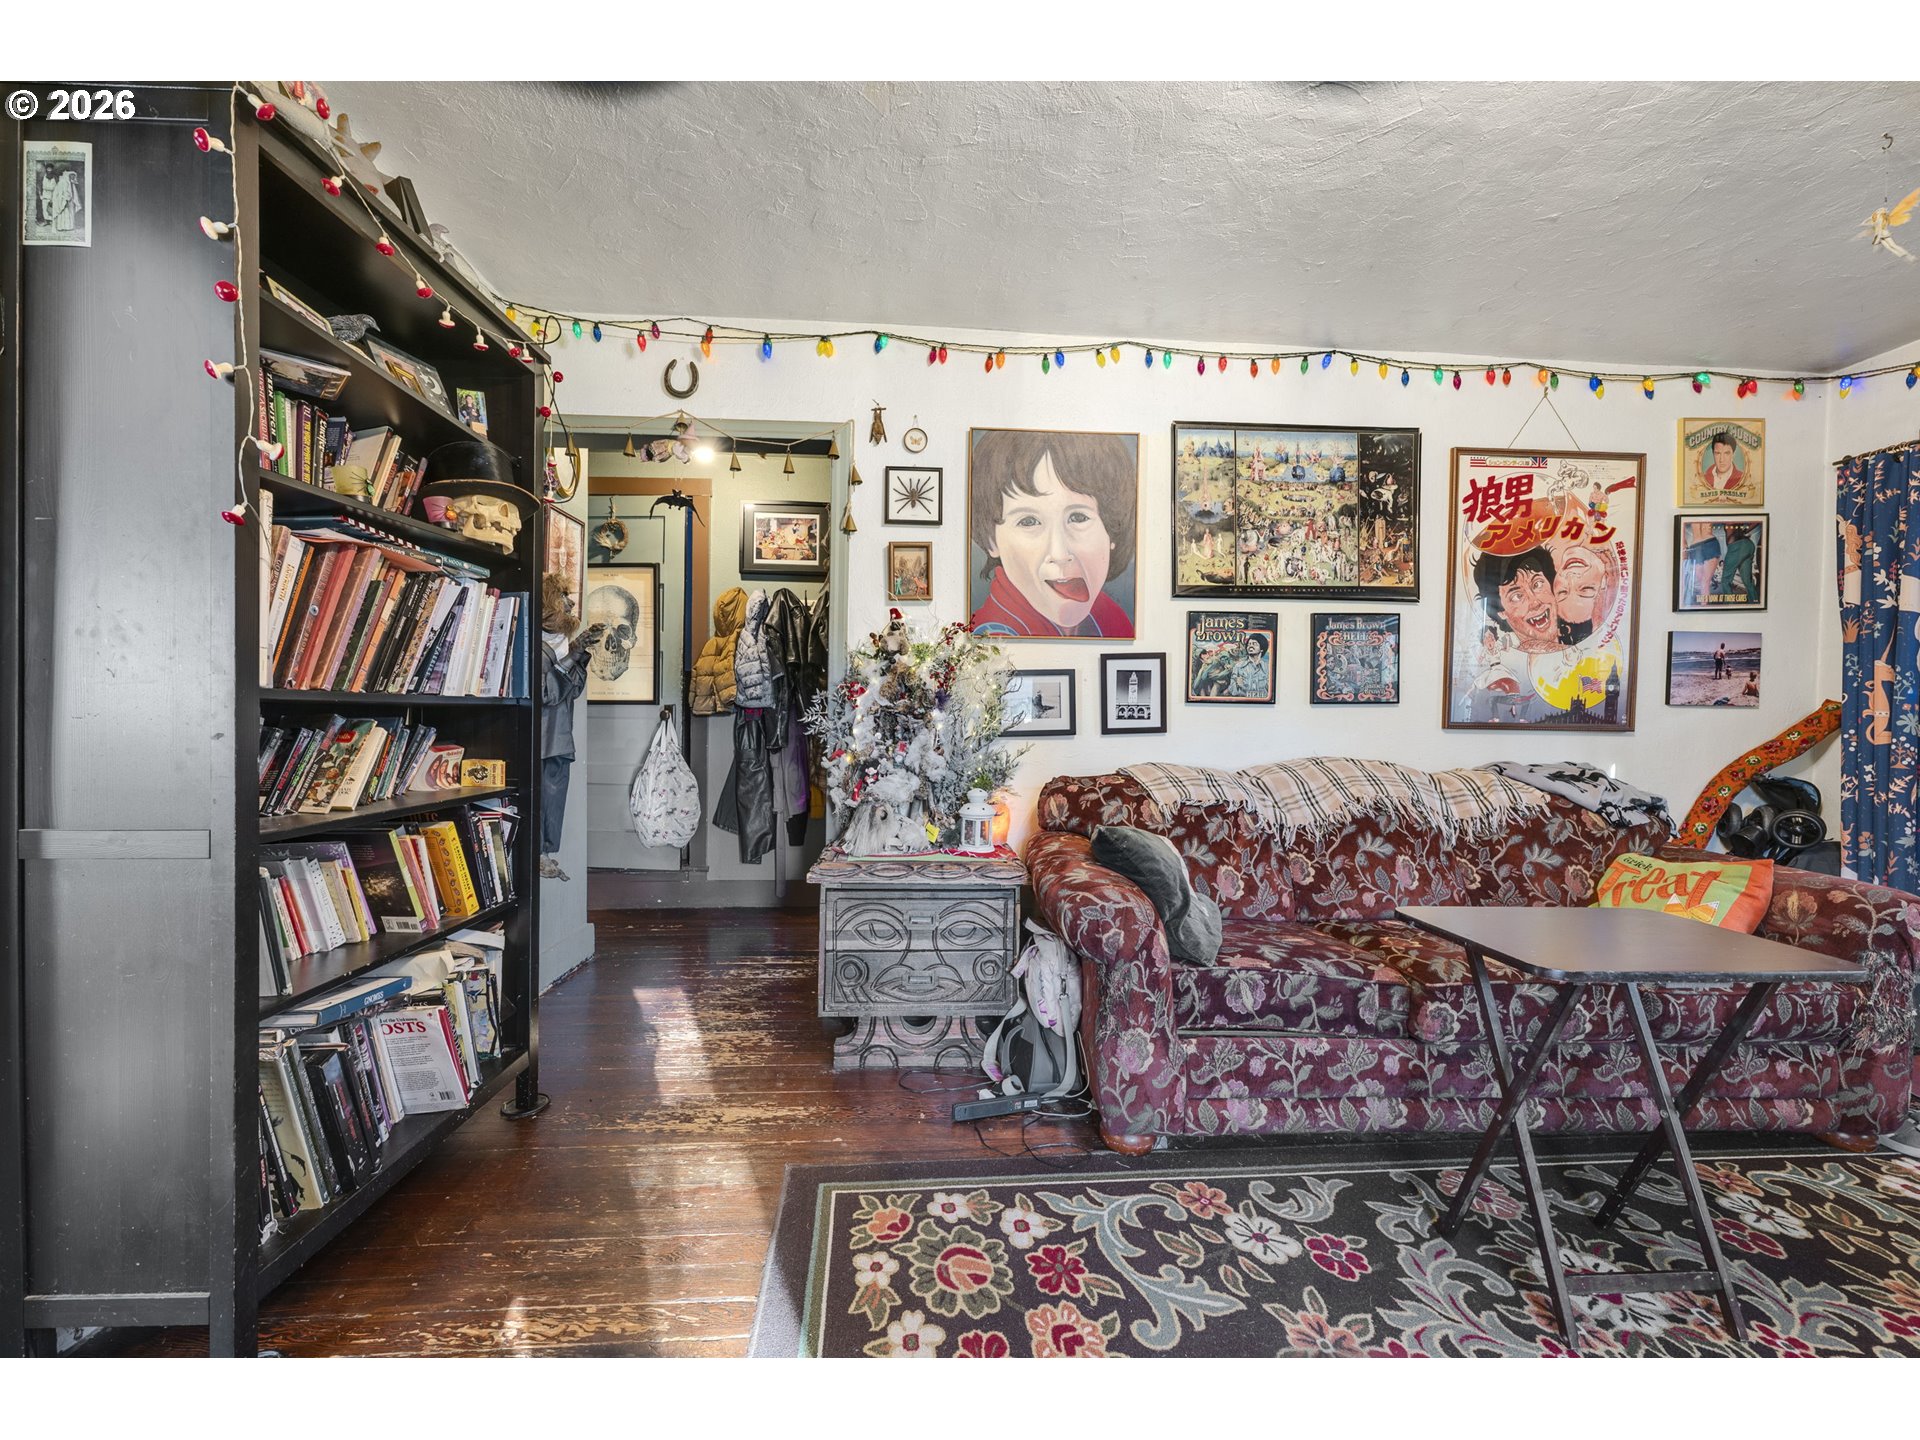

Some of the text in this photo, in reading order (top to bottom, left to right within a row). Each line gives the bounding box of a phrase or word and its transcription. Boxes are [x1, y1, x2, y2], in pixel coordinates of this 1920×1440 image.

[1689, 424, 1758, 448] COUNTRY MUSIC
[1462, 474, 1534, 524] 狼男
[1479, 514, 1618, 550] アメリカン
[1598, 862, 1723, 908] Treat
[381, 1021, 426, 1035] OSTS
